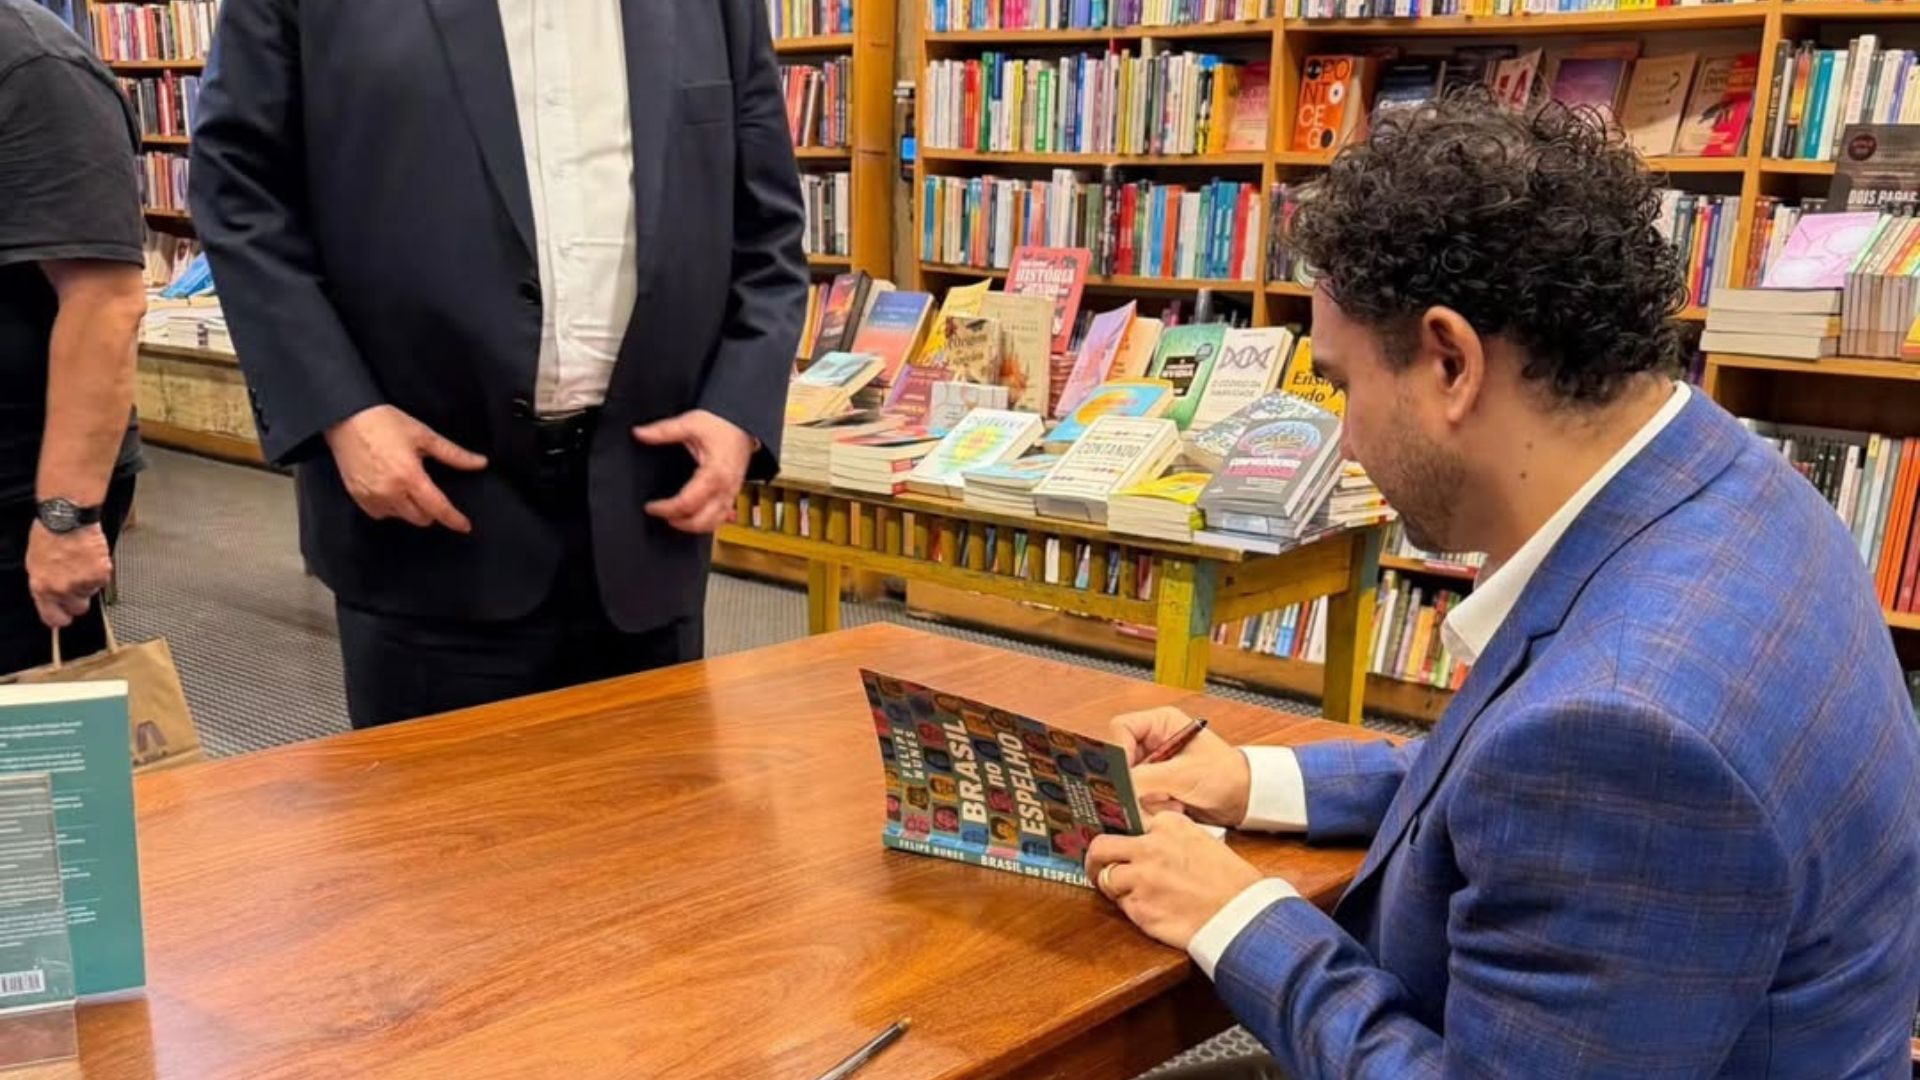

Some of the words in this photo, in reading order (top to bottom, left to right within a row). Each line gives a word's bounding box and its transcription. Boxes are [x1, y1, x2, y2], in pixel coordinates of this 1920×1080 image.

[893, 727, 912, 778] FELIPE
[904, 731, 925, 780] NUNES
[942, 719, 988, 823] BRASIL
[984, 761, 1006, 788] no
[998, 732, 1048, 836] ESPELHO
[981, 854, 1023, 873] BRASIL
